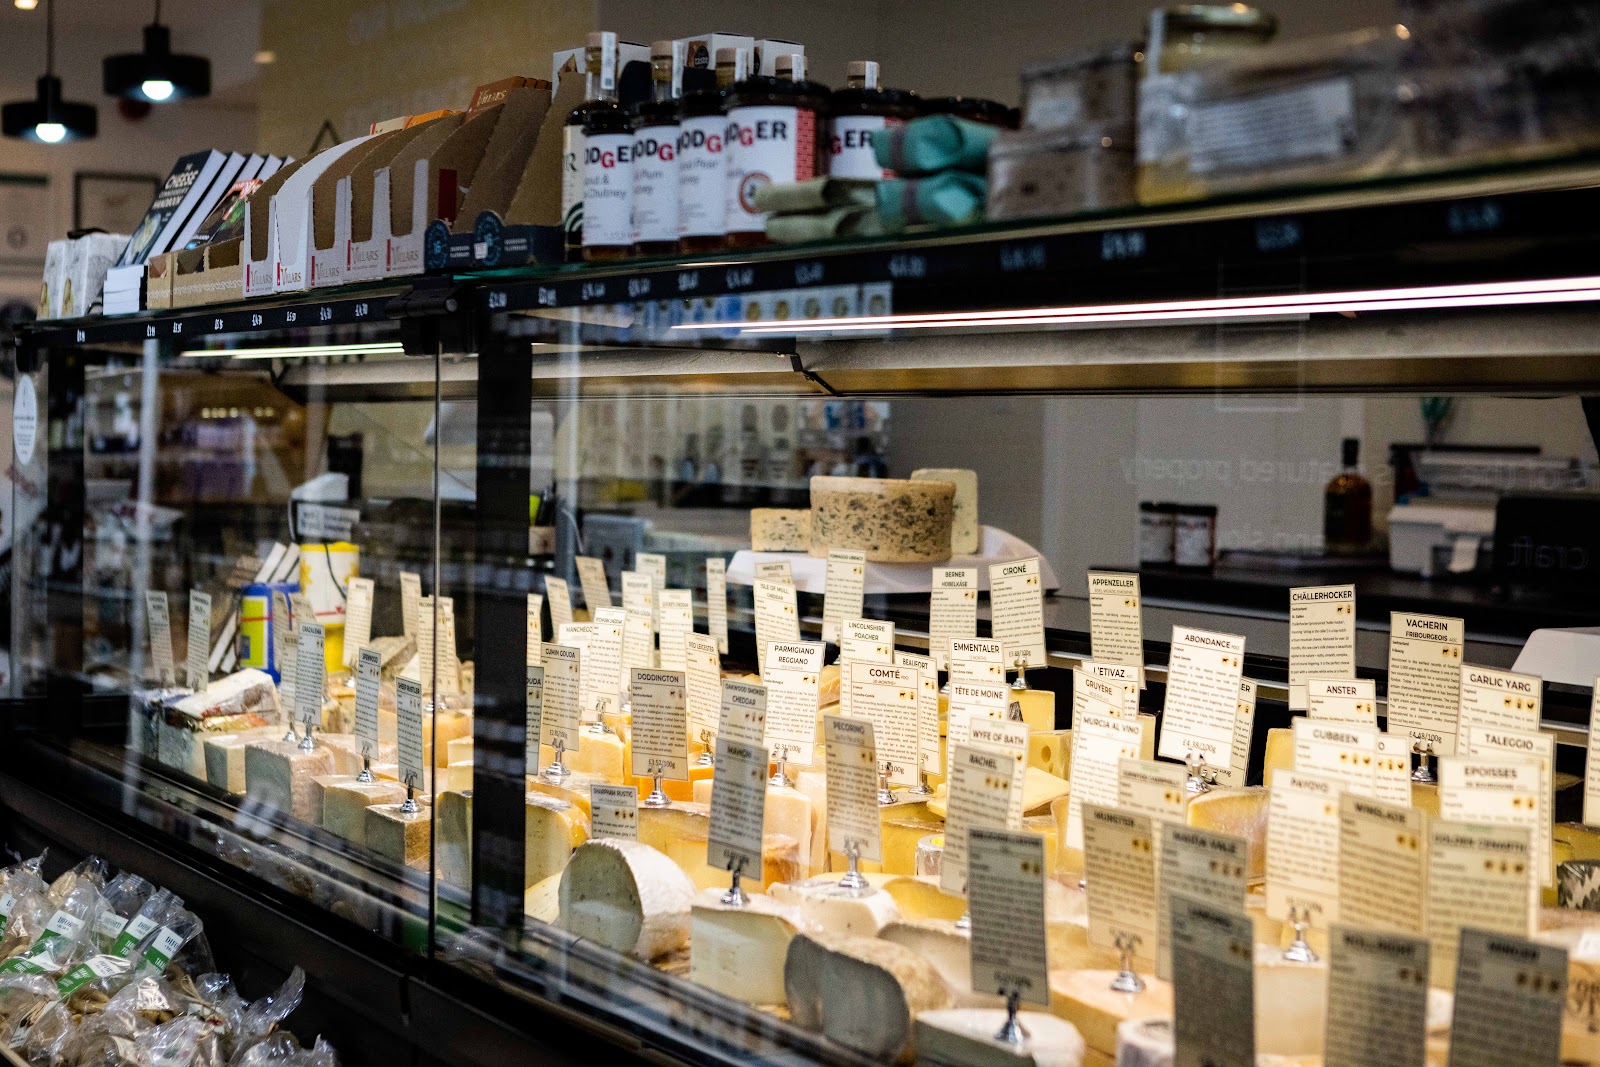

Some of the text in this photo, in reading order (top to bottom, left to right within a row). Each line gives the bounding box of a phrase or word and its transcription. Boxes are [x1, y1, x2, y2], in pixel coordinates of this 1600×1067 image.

[1003, 563, 1026, 575] CIRONÉ
[1092, 578, 1134, 587] APPENZELLER
[760, 583, 770, 591] ISLE
[777, 586, 789, 594] MULL
[766, 592, 784, 600] CHEDDAR
[848, 622, 885, 632] LINCOLNSHIRE
[1405, 618, 1448, 631] VACHERIN
[854, 632, 879, 641] POACHER
[1185, 634, 1231, 649] ABONDANCE
[1405, 631, 1448, 642] FRIBOURGEOIS
[559, 649, 576, 658] GOUDA
[774, 645, 815, 655] PARMIGIANO
[953, 642, 1000, 654] EMMENTALER
[778, 656, 809, 665] REGGIANO
[902, 657, 929, 670] BEAUFORT
[637, 673, 679, 683] DODDINGTON
[869, 668, 901, 679] COMTÉ
[526, 677, 542, 686] OUDA
[1470, 673, 1531, 692] GARLIC YARG
[955, 686, 1003, 700] TÊTE DE MOINE
[1085, 679, 1113, 696] GRUYÈRE
[1326, 685, 1357, 695] ANSTER
[832, 721, 865, 734] PECORINO
[1083, 717, 1139, 735] MURCIA AL VINO
[973, 729, 1024, 745] WYFE OF BATH
[1485, 734, 1534, 750] TALEGGIO
[969, 753, 998, 770] RACHEL
